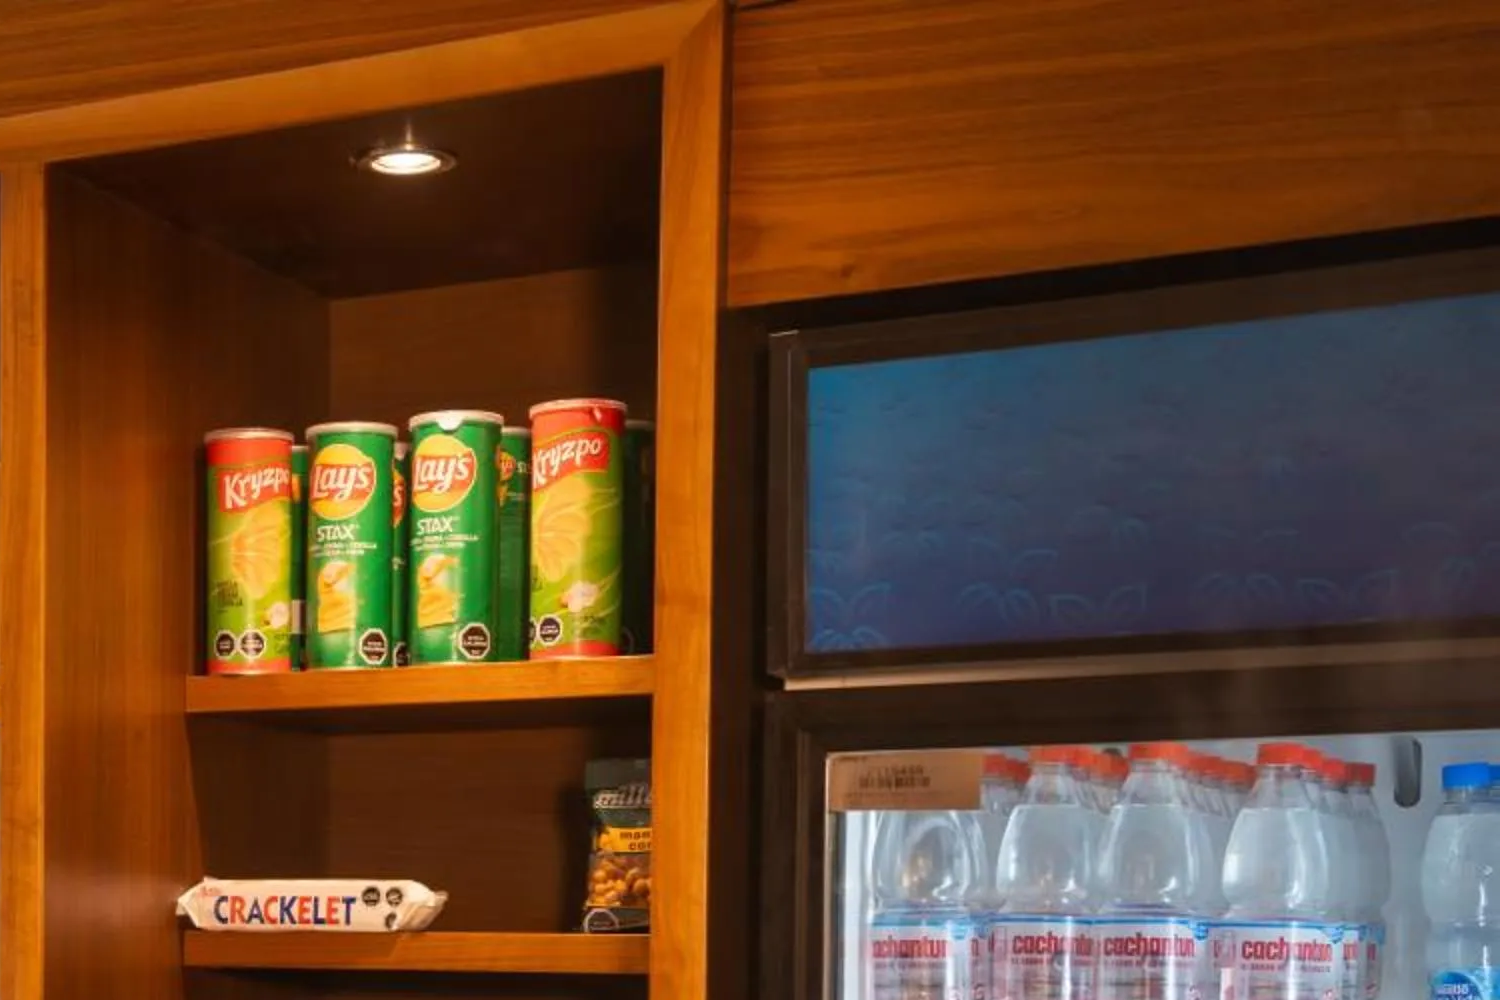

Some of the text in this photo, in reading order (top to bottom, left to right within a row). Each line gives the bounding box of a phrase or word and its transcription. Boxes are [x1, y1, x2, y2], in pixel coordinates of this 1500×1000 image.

[412, 453, 472, 495] Lay's
[532, 438, 602, 490] Kryzpo
[313, 464, 372, 501] Lay's
[316, 524, 356, 542] STAX
[416, 516, 453, 535] STAX
[213, 895, 357, 926] CRACKELET
